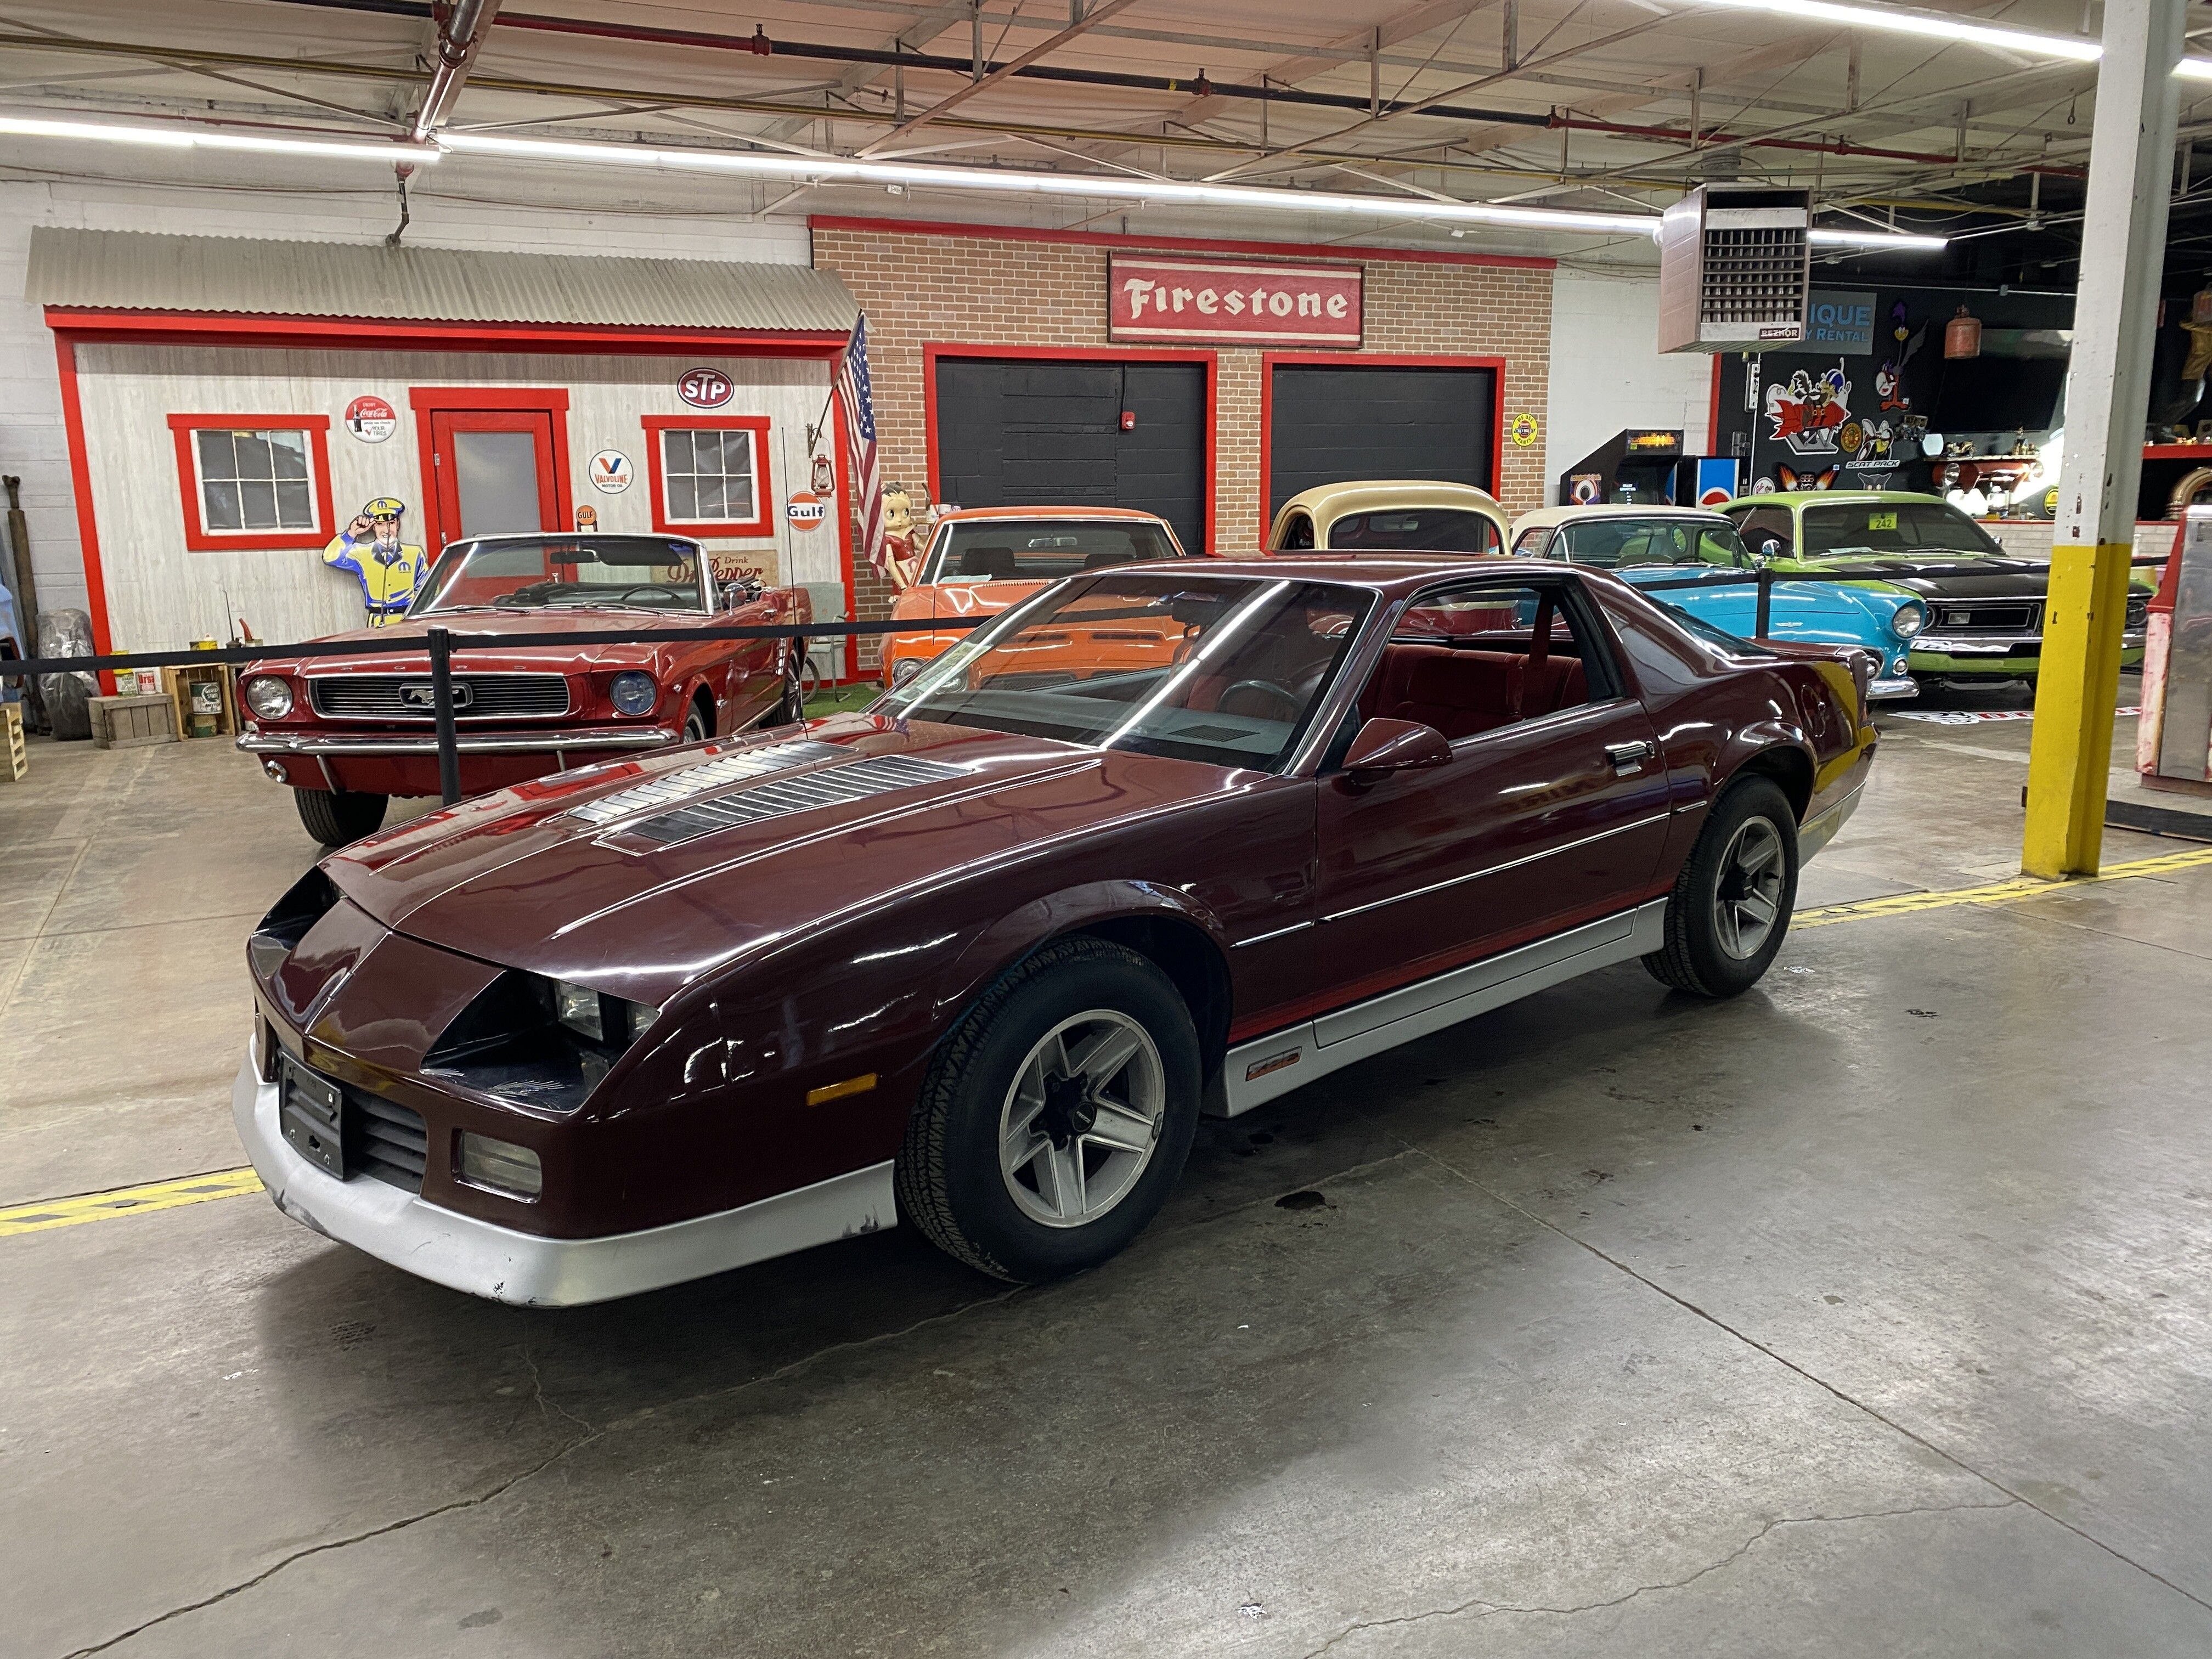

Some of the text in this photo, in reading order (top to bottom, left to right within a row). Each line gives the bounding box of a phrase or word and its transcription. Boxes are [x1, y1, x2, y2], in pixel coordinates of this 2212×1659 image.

[1124, 278, 1348, 319] Firestone
[1809, 303, 1871, 328] IQUE
[1761, 329, 1798, 337] REZNOR
[1805, 328, 1868, 341] Y RENTAL
[685, 373, 726, 400] STP
[595, 474, 628, 484] VALVOLINE
[578, 511, 593, 519] GULF
[787, 505, 824, 517] Gulf
[1876, 519, 1892, 528] 242
[724, 551, 749, 564] Drink
